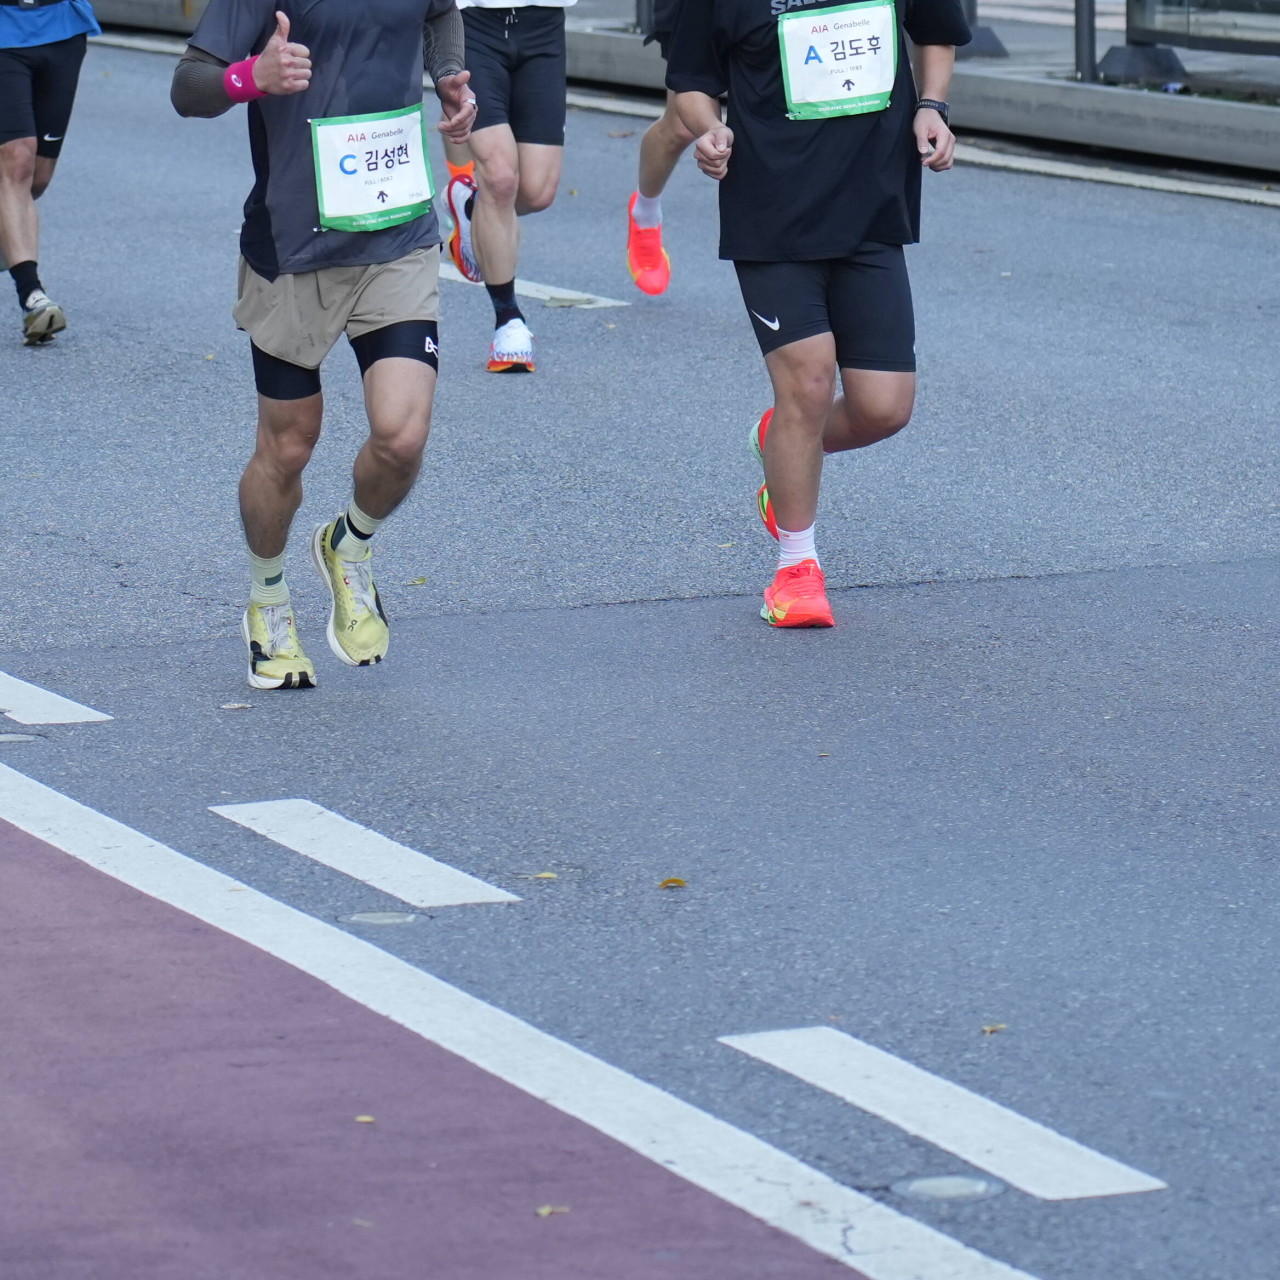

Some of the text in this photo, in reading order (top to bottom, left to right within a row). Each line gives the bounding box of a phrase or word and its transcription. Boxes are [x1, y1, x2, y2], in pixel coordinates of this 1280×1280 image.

[811, 19, 871, 35] AIA Genabelle
[804, 35, 881, 65] A 김도후
[347, 128, 404, 143] AIA Genabelle
[339, 143, 410, 175] C 김성현
